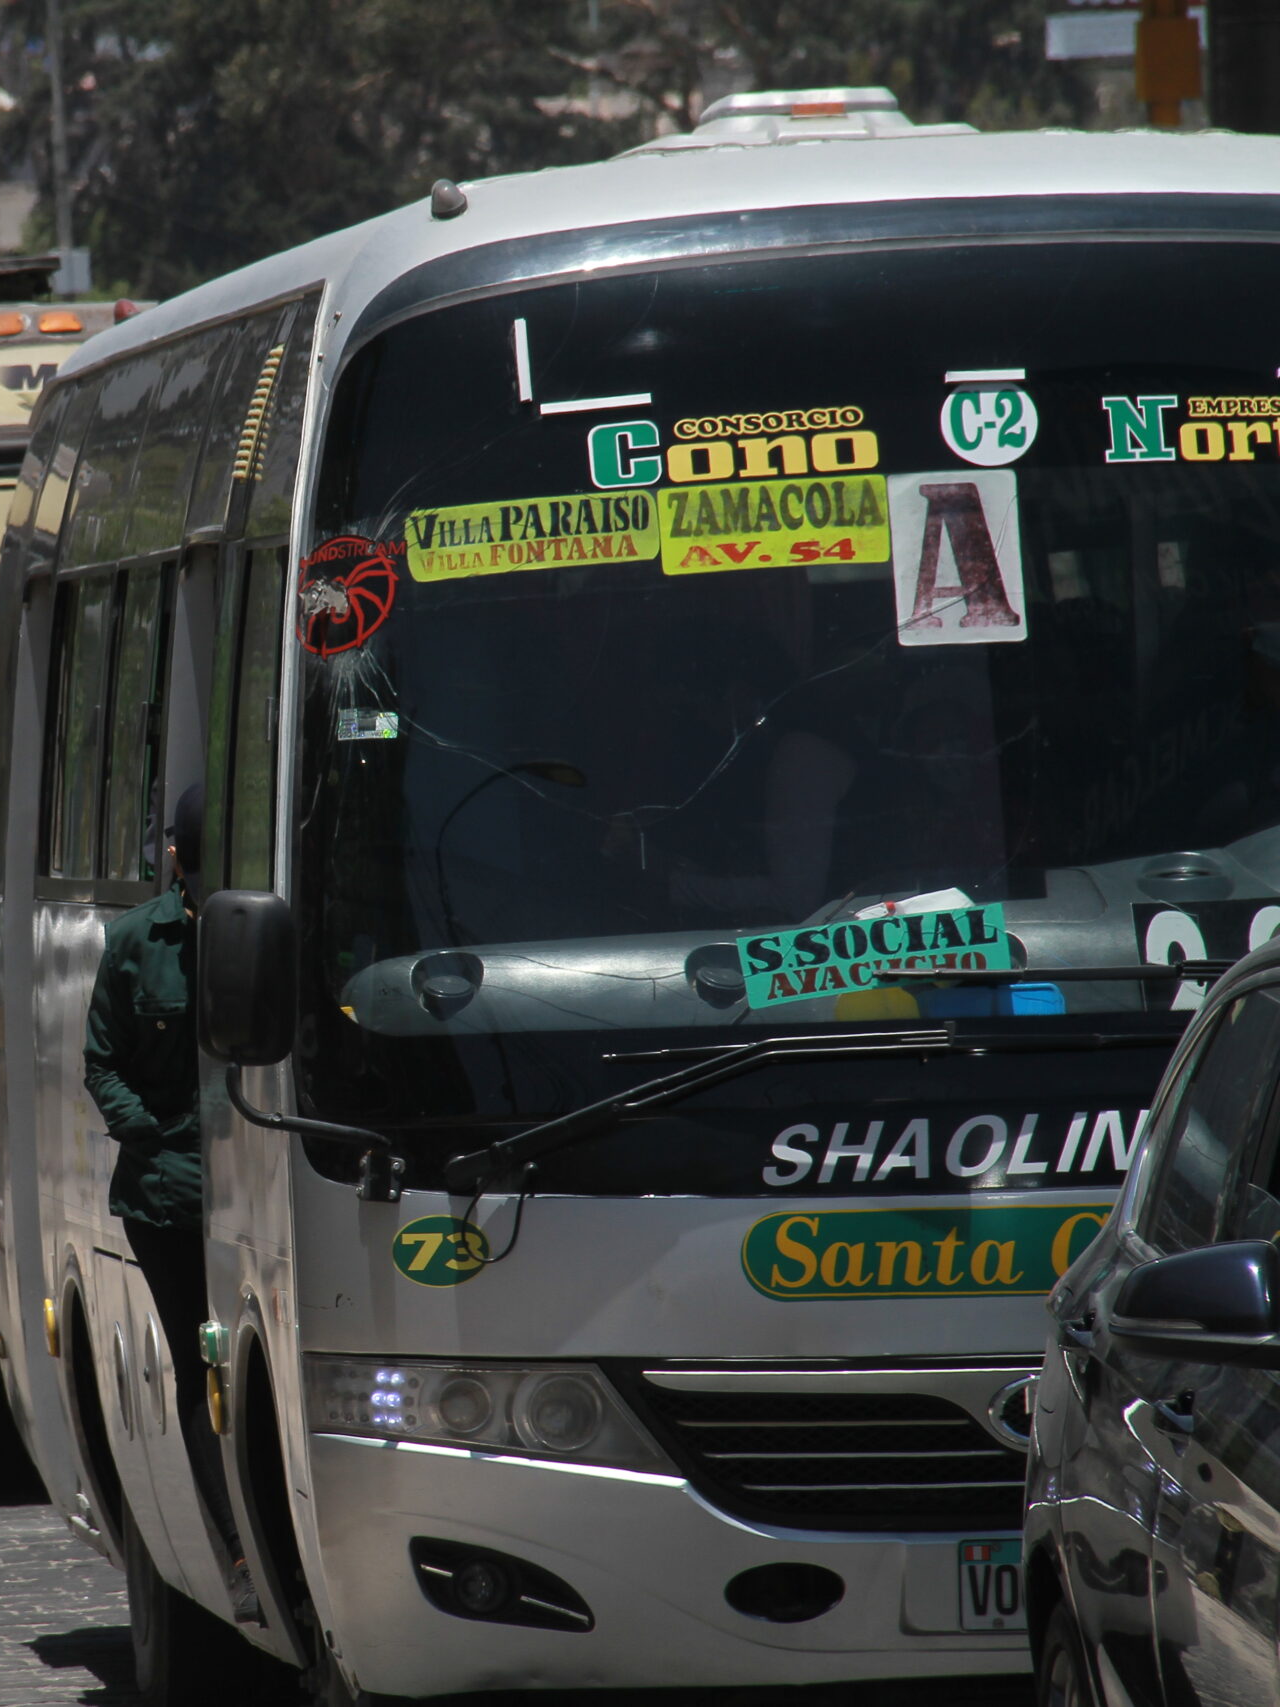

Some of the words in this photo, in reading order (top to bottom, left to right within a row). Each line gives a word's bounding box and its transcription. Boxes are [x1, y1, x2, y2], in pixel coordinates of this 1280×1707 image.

[673, 405, 864, 440] CONSORCIO
[949, 388, 1028, 452] C-2
[1102, 394, 1280, 463] Nor
[587, 420, 880, 489] Cono
[410, 513, 495, 550] VILLA
[498, 495, 650, 541] PARAISO
[667, 479, 886, 539] ZAMACOLA
[420, 551, 484, 574] VILLA
[489, 534, 639, 567] FONTANA
[678, 541, 772, 567] AV.
[787, 537, 856, 563] 54
[903, 481, 1021, 630] A
[761, 1108, 1150, 1187] SHAOLIN
[401, 1231, 485, 1271] 73
[770, 1215, 1024, 1288] Santa
